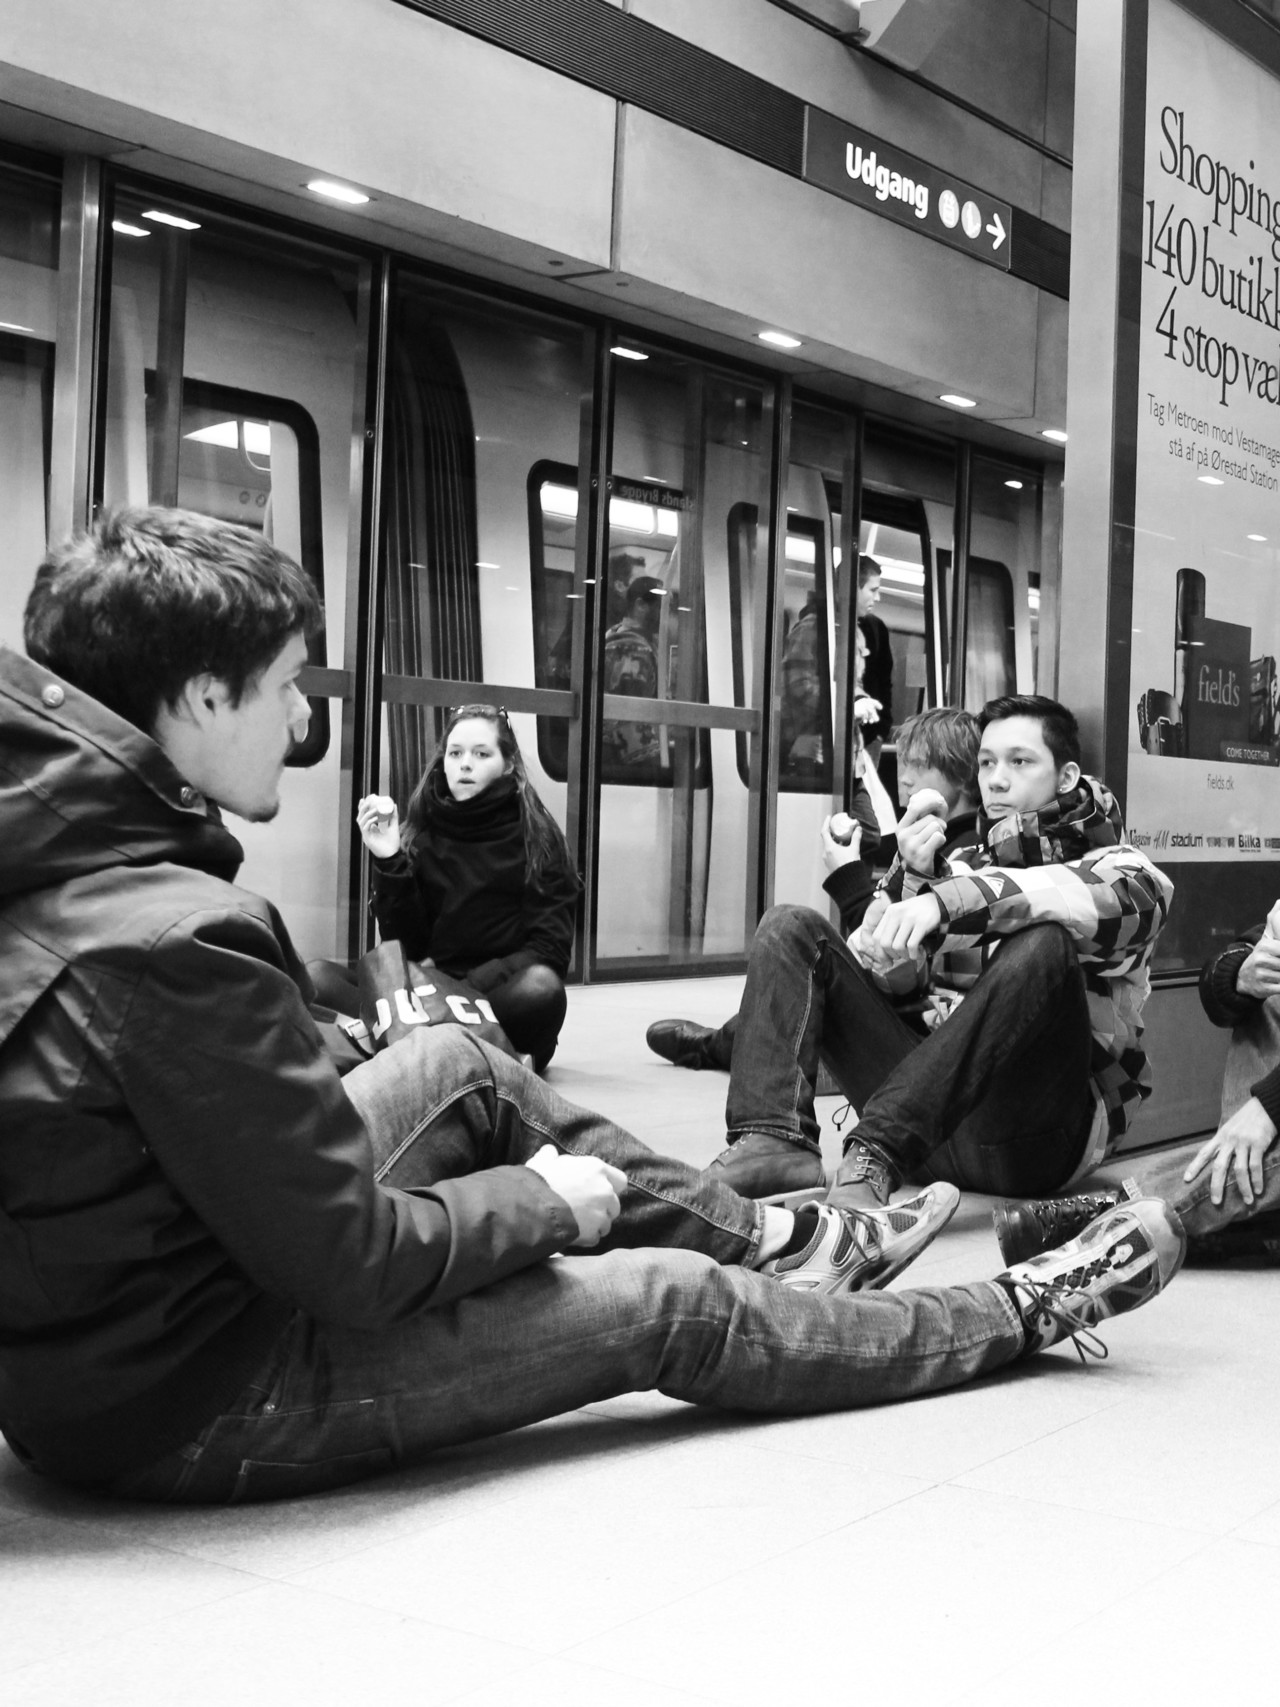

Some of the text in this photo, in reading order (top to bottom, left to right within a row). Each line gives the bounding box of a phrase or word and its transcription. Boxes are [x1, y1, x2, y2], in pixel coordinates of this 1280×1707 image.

[845, 142, 929, 219] Udgang
[1144, 199, 1197, 286] 140
[1155, 286, 1178, 360] 4
[1182, 325, 1239, 407] stop
[1147, 393, 1165, 426] Tag
[1167, 402, 1209, 437] Metroen
[1212, 426, 1234, 446] mod
[1169, 438, 1279, 492] stå af på Ørestad Station
[1198, 664, 1240, 707] field's
[1226, 747, 1243, 759] COME
[1207, 773, 1235, 791] fields.dk
[1238, 834, 1261, 849] Bilka
